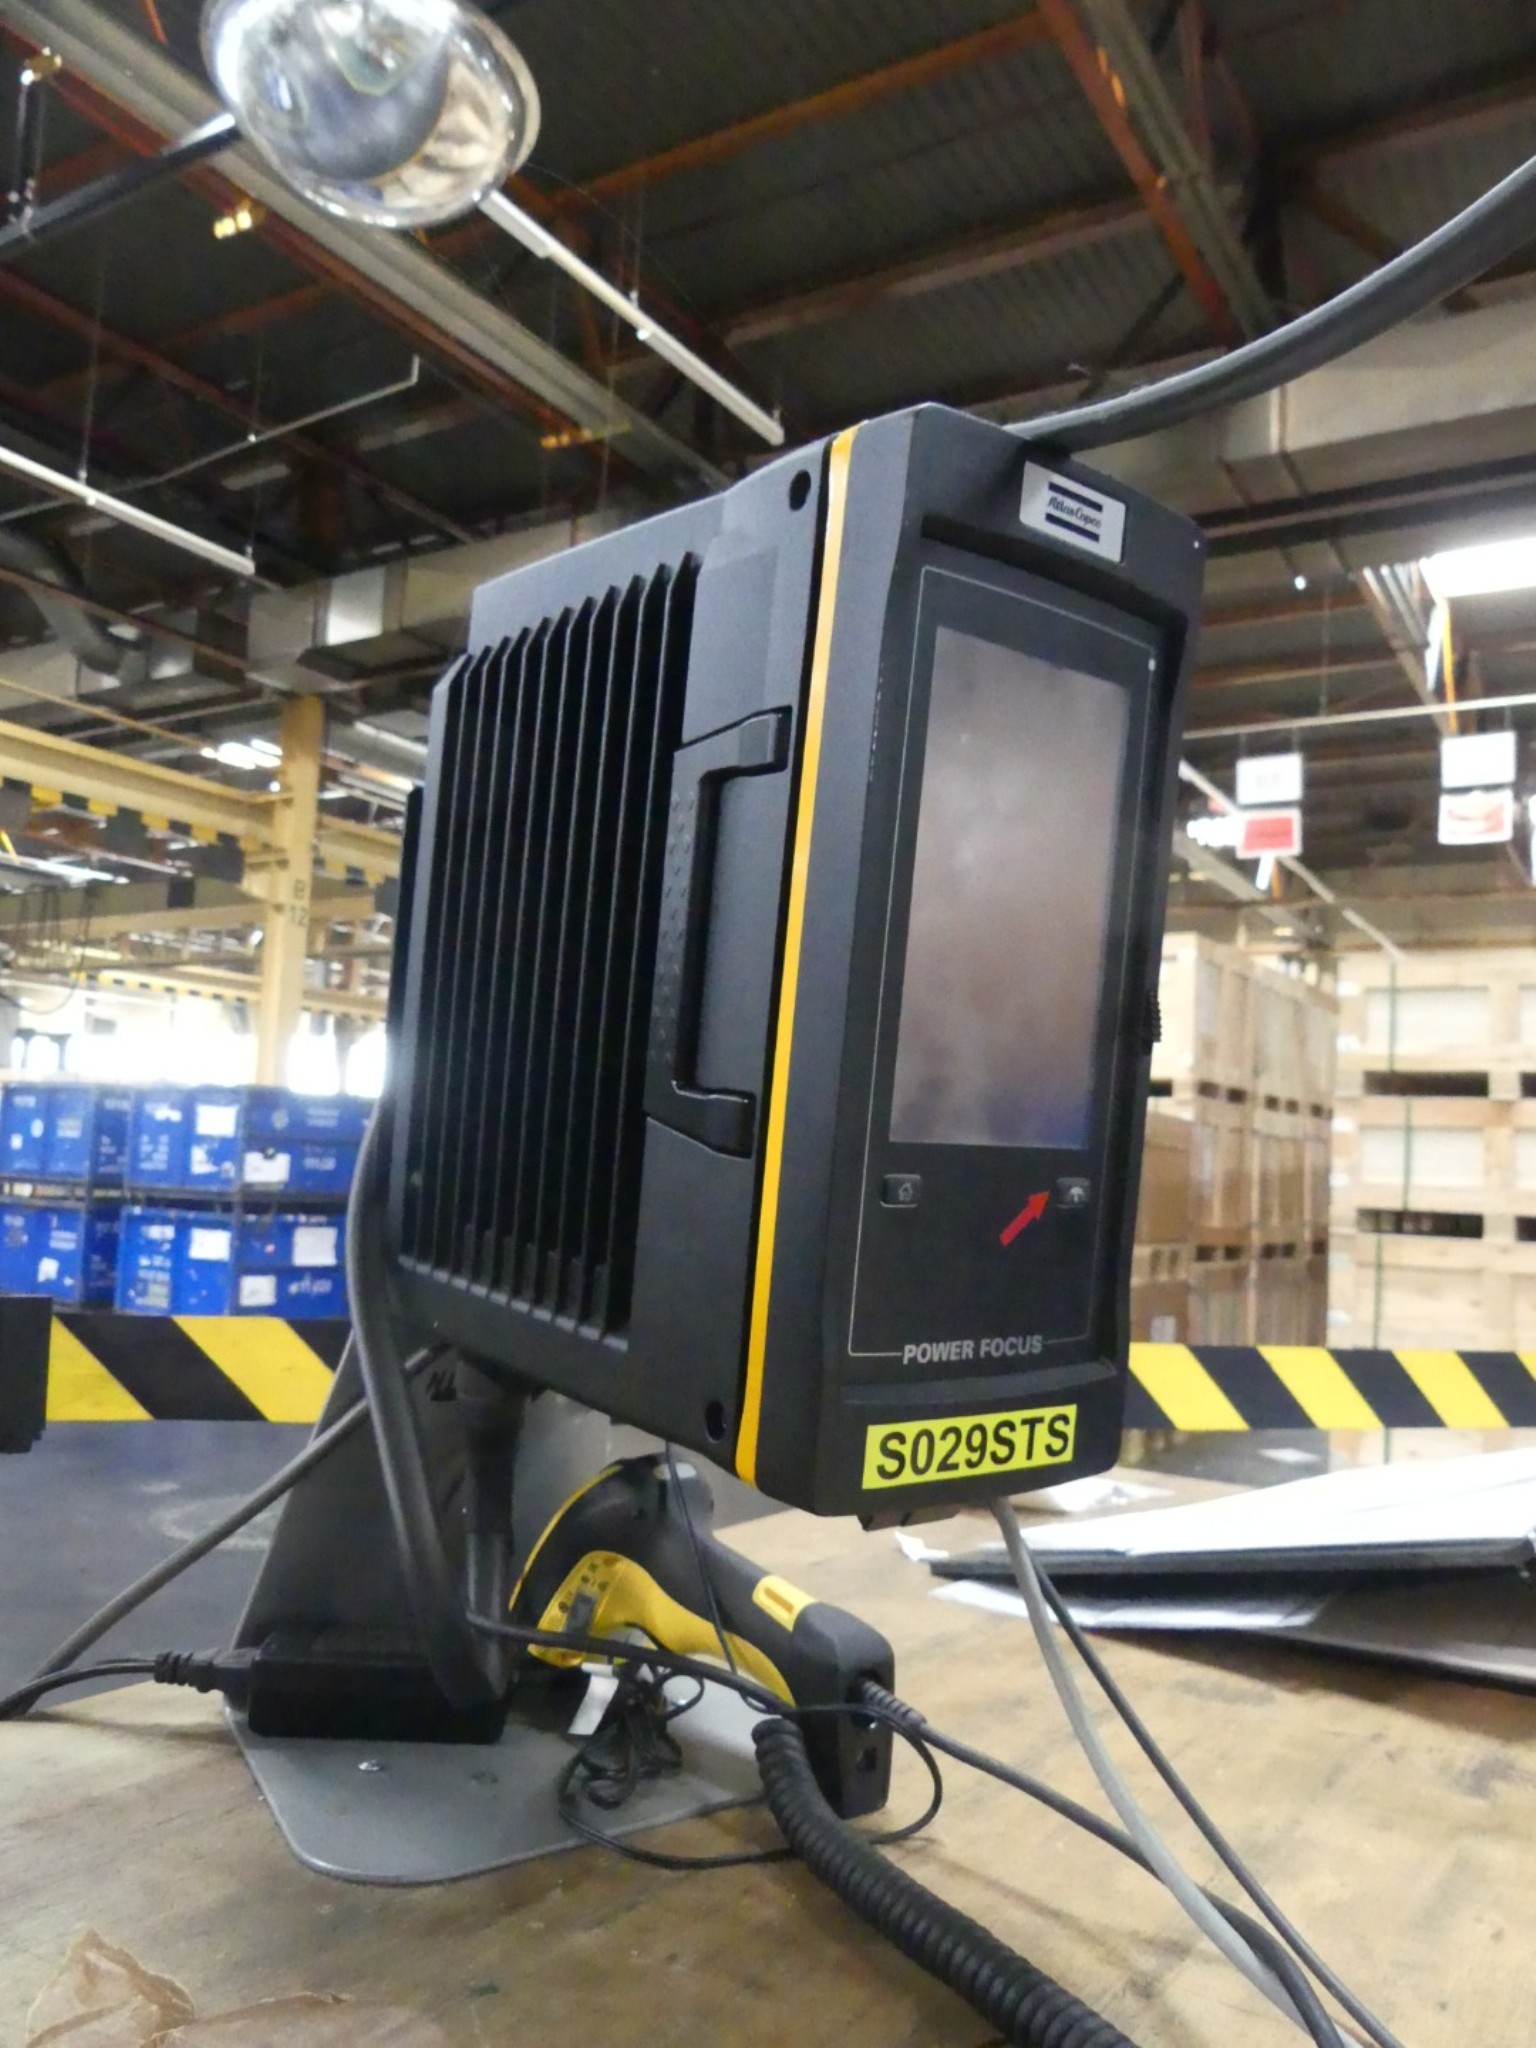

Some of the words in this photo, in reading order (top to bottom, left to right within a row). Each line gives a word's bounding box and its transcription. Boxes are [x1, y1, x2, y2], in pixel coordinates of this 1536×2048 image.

[902, 1339, 975, 1365] POWER
[979, 1334, 1043, 1359] FOCUS
[876, 1413, 1071, 1480] S029STS
